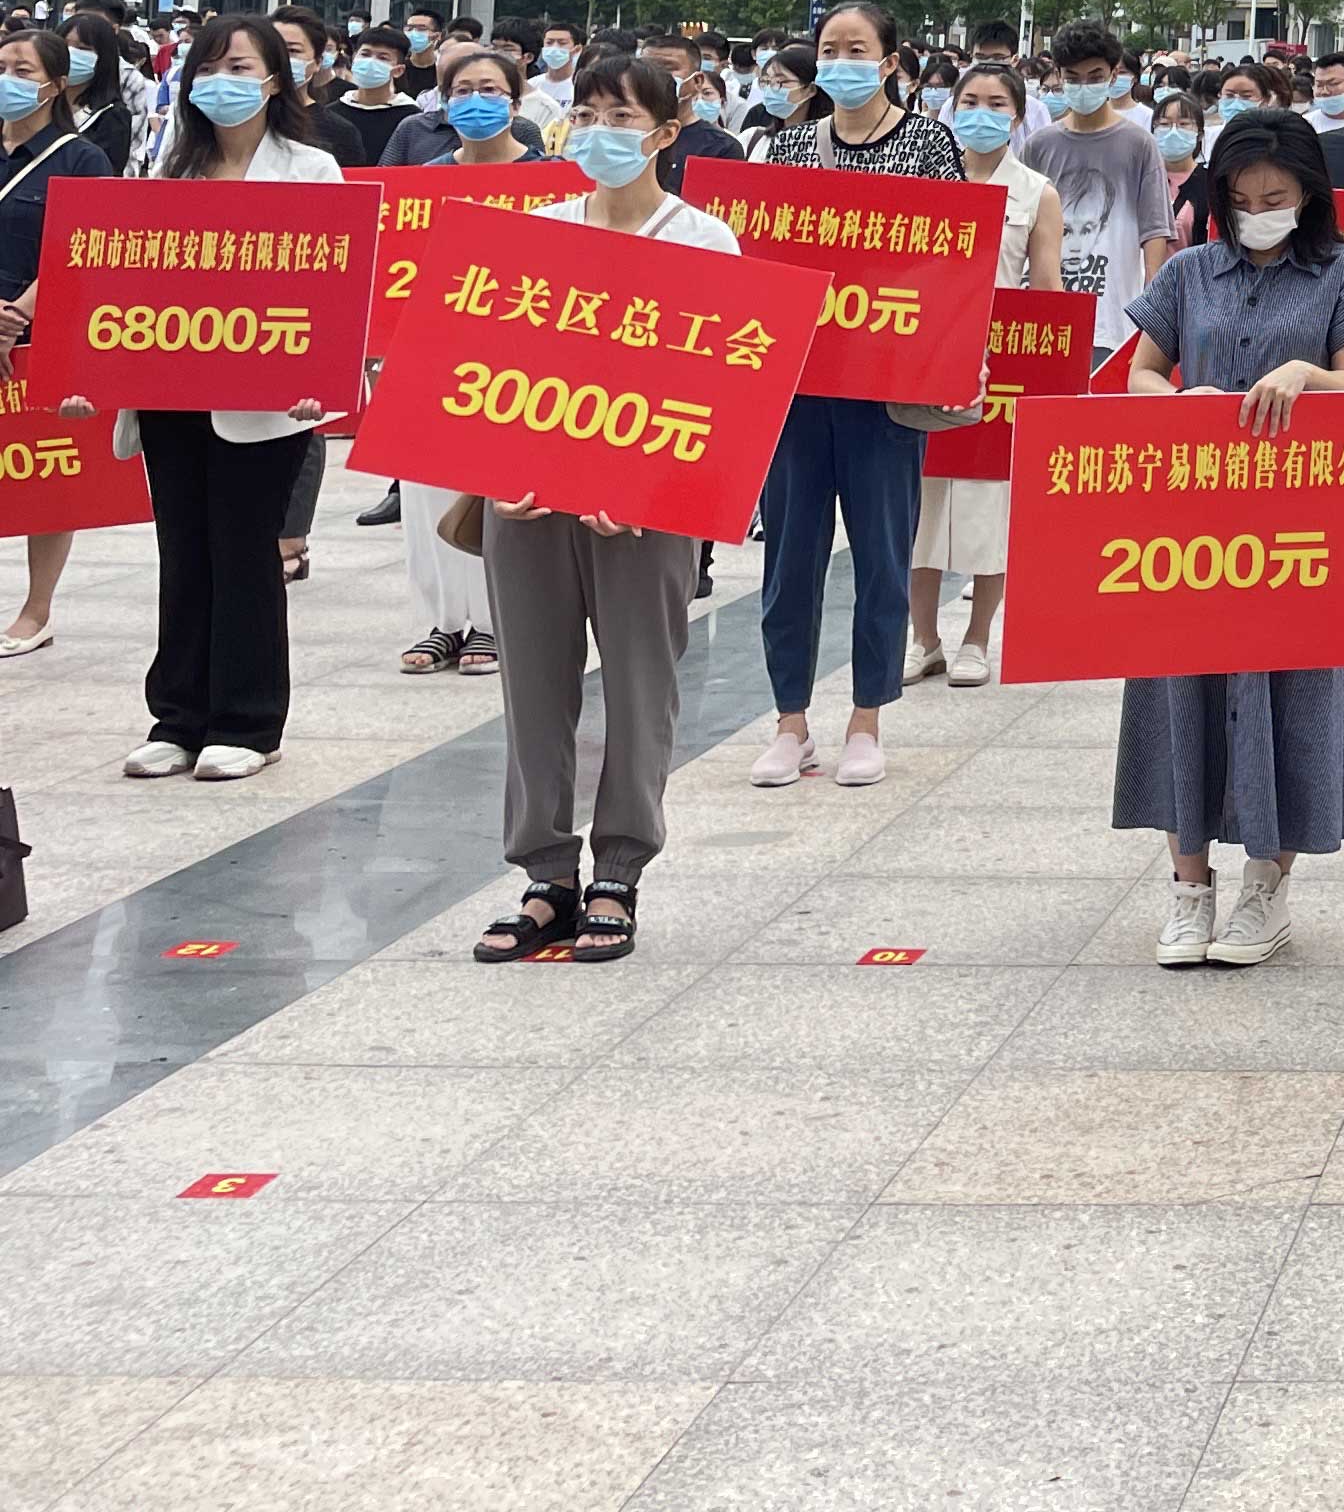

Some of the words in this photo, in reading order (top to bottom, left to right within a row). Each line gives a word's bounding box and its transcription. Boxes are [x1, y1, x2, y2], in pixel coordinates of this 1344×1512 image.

[88, 305, 311, 355] 68000元
[444, 264, 777, 371] 北关区总工会
[442, 361, 713, 462] 30000元
[0, 437, 81, 480] 0元
[1098, 531, 1329, 594] 2000元
